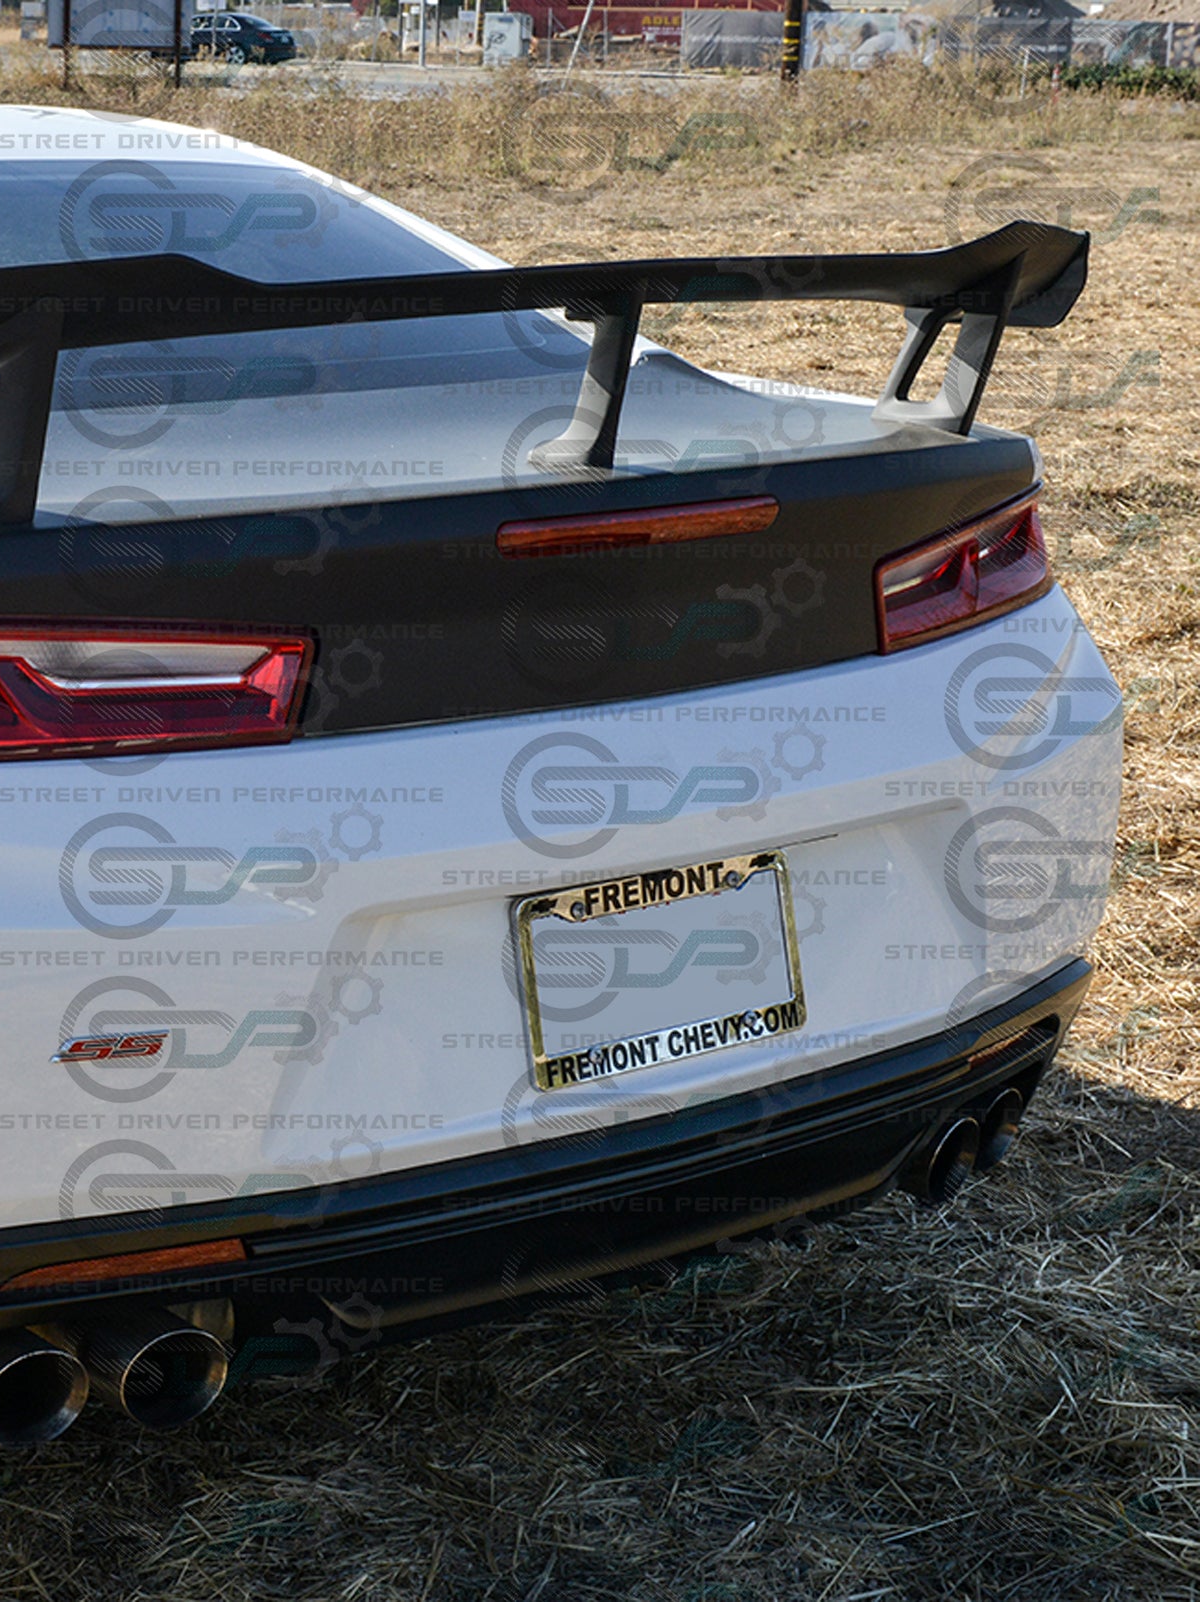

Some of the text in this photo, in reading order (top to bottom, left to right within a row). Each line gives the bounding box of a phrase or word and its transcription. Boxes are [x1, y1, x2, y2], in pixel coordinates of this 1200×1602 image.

[583, 861, 724, 916] FREMONT
[50, 1029, 170, 1064] SS
[546, 1034, 660, 1088] FREMONT
